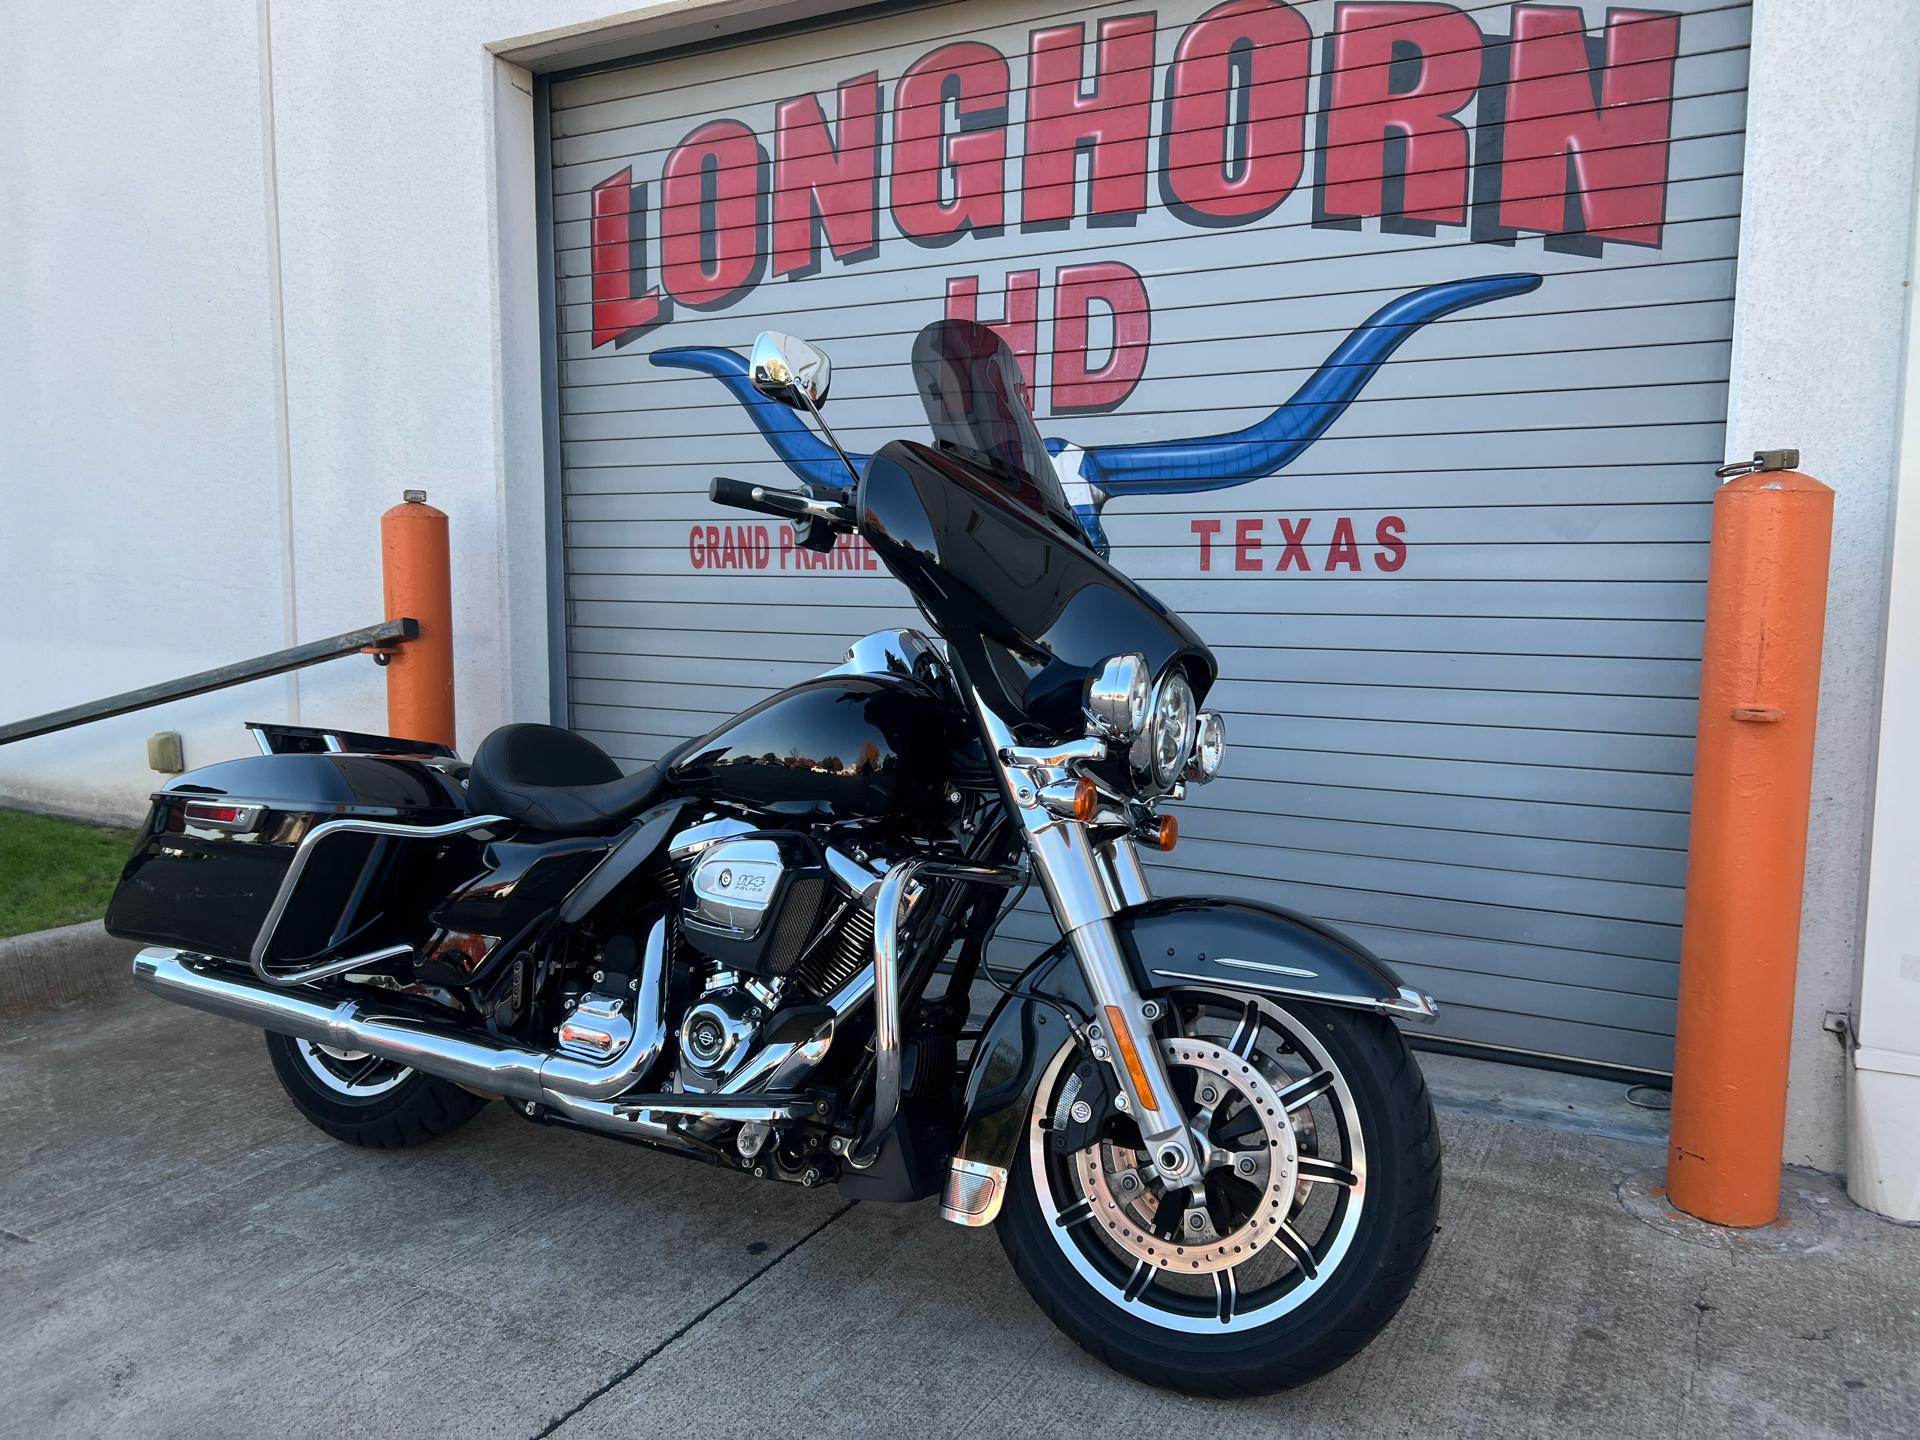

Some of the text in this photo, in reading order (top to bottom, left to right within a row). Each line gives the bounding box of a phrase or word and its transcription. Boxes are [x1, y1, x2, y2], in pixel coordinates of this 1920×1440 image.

[591, 0, 1681, 349] LONGHORN
[942, 260, 1151, 421] HD
[689, 525, 770, 570] GRAND
[1190, 515, 1408, 573] TEXAS
[736, 874, 766, 887] 114
